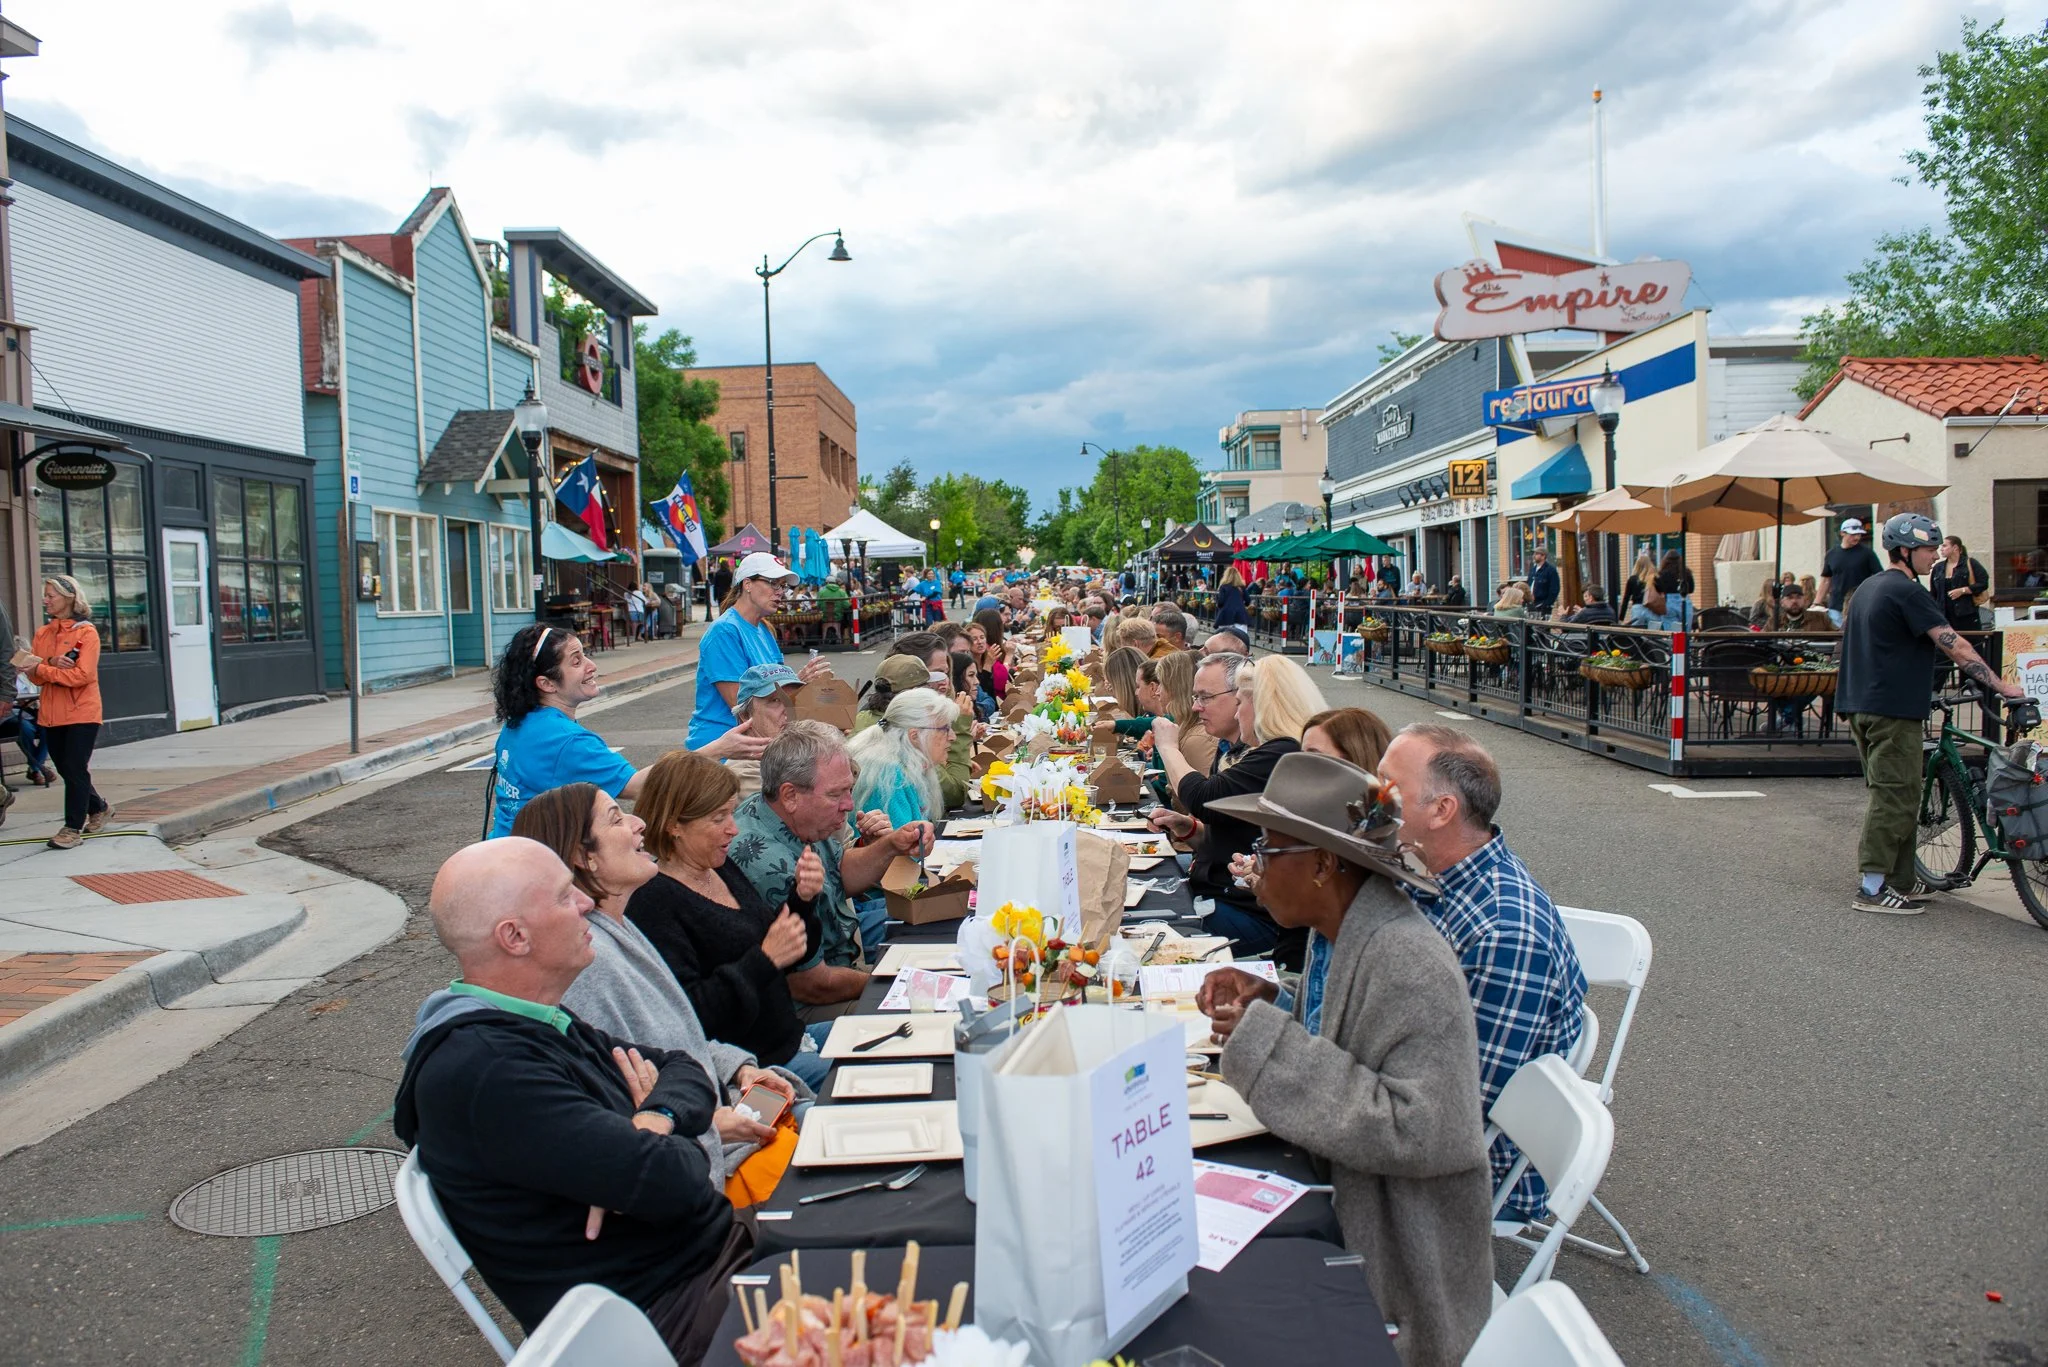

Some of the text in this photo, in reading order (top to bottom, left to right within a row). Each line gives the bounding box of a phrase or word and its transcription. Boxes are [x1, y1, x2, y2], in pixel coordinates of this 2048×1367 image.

[1462, 269, 1668, 325] Empire
[1489, 372, 1600, 420] restaura
[1376, 421, 1407, 445] MARKETPLACE
[1454, 486, 1482, 494] BREWING
[1112, 1102, 1172, 1160] TABLE
[1136, 1155, 1155, 1181] 42
